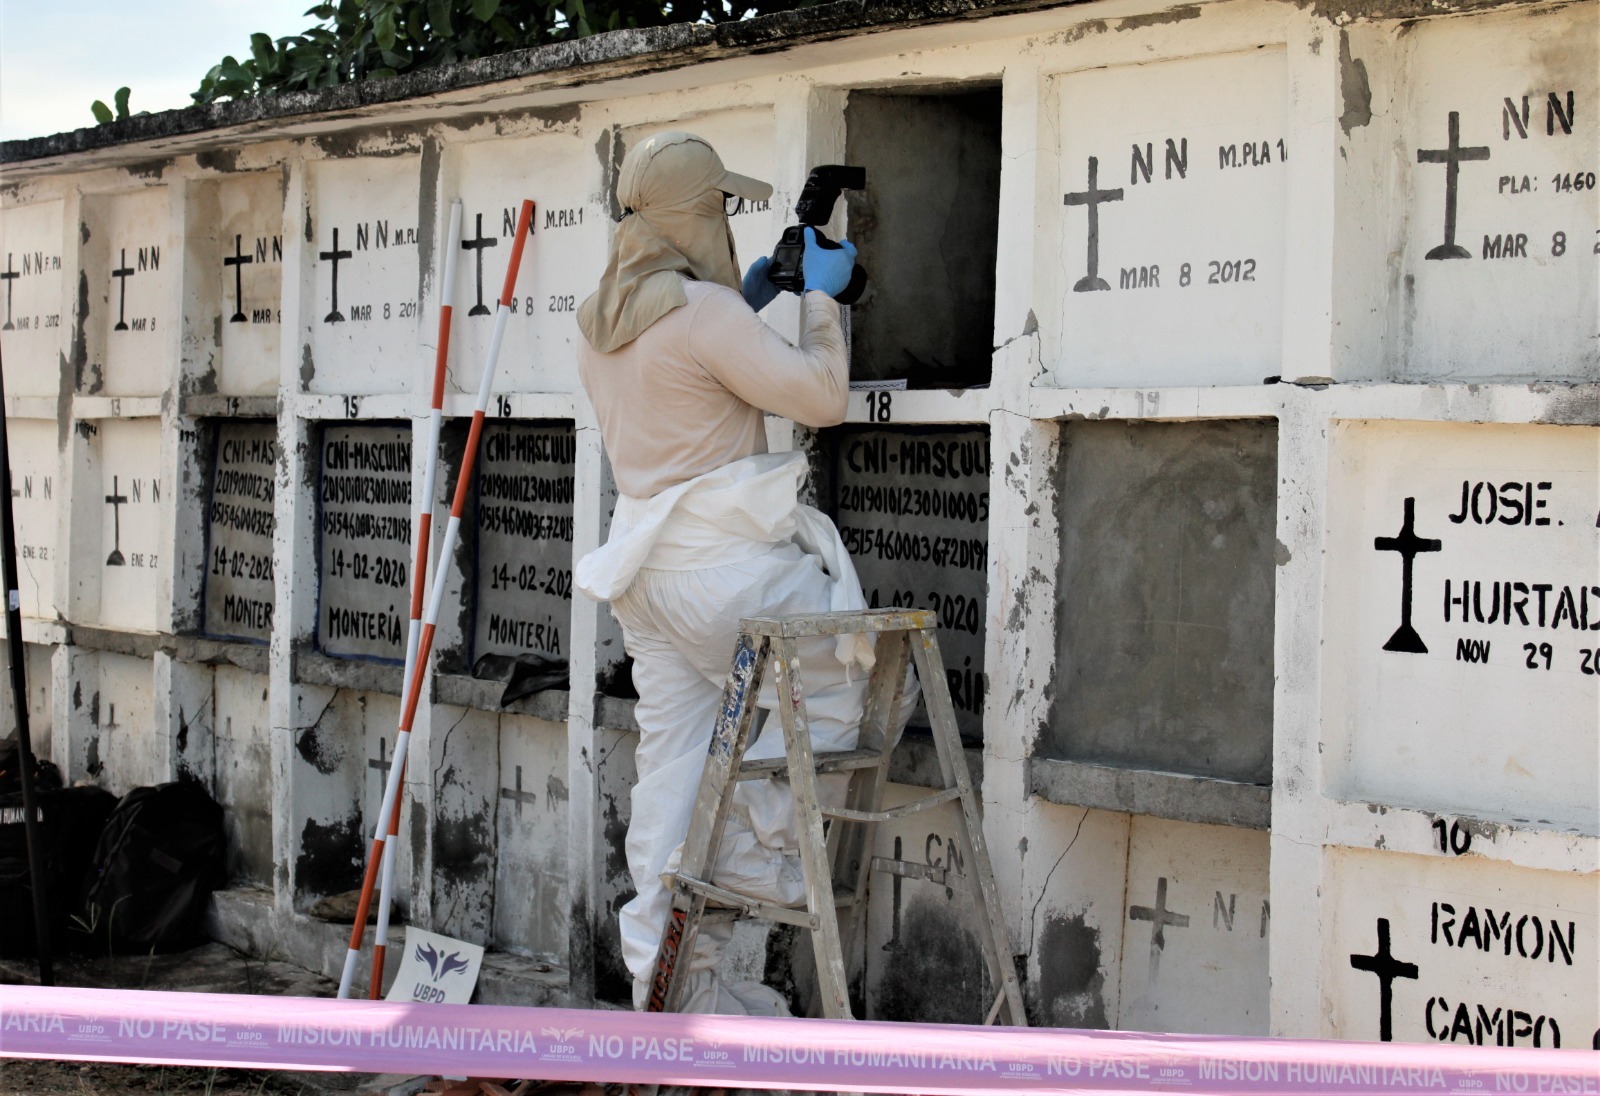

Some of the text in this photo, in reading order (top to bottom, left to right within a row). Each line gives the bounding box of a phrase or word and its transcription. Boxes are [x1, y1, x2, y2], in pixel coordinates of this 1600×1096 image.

[1483, 232, 1528, 260] MAR
[1551, 231, 1566, 256] 8
[1120, 258, 1257, 290] MAR 8 2012
[252, 308, 271, 324] MAR
[351, 304, 372, 321] MAR
[383, 302, 391, 320] 8
[526, 296, 534, 317] 8
[548, 295, 576, 313] 2012
[17, 316, 30, 331] MAR
[45, 314, 60, 328] 2012
[131, 317, 156, 331] MAR 8
[343, 397, 358, 418] 15
[497, 395, 511, 418] 16
[866, 390, 892, 423] 18
[131, 552, 158, 569] ENE 22
[331, 548, 406, 588] 14-02-2020
[1456, 637, 1491, 665] NOV
[1523, 642, 1553, 671] 29
[1432, 818, 1471, 855] 10
[1430, 901, 1576, 966] RAMON
[413, 982, 446, 1004] UBPD
[1425, 996, 1561, 1049] CAMPO
[79, 1024, 104, 1034] UBPD
[118, 1015, 155, 1039] NO
[162, 1018, 226, 1043] PASE
[236, 1031, 262, 1041] UBPD
[370, 1023, 537, 1054] HUMANITARIA
[550, 1044, 575, 1054] UBPD
[588, 1033, 623, 1059] NO
[631, 1036, 694, 1063] PASE
[703, 1050, 728, 1060] UBPD
[833, 1045, 997, 1072] HUMANITARIA
[1009, 1063, 1034, 1072] UBPD
[1047, 1055, 1082, 1078] NO
[1089, 1057, 1150, 1080] PASE
[1160, 1068, 1184, 1077] UBPD
[1287, 1061, 1447, 1088] HUMANITARIA
[1459, 1079, 1483, 1088] UBPD
[1495, 1071, 1529, 1093] NO
[1537, 1073, 1597, 1095] PASE
